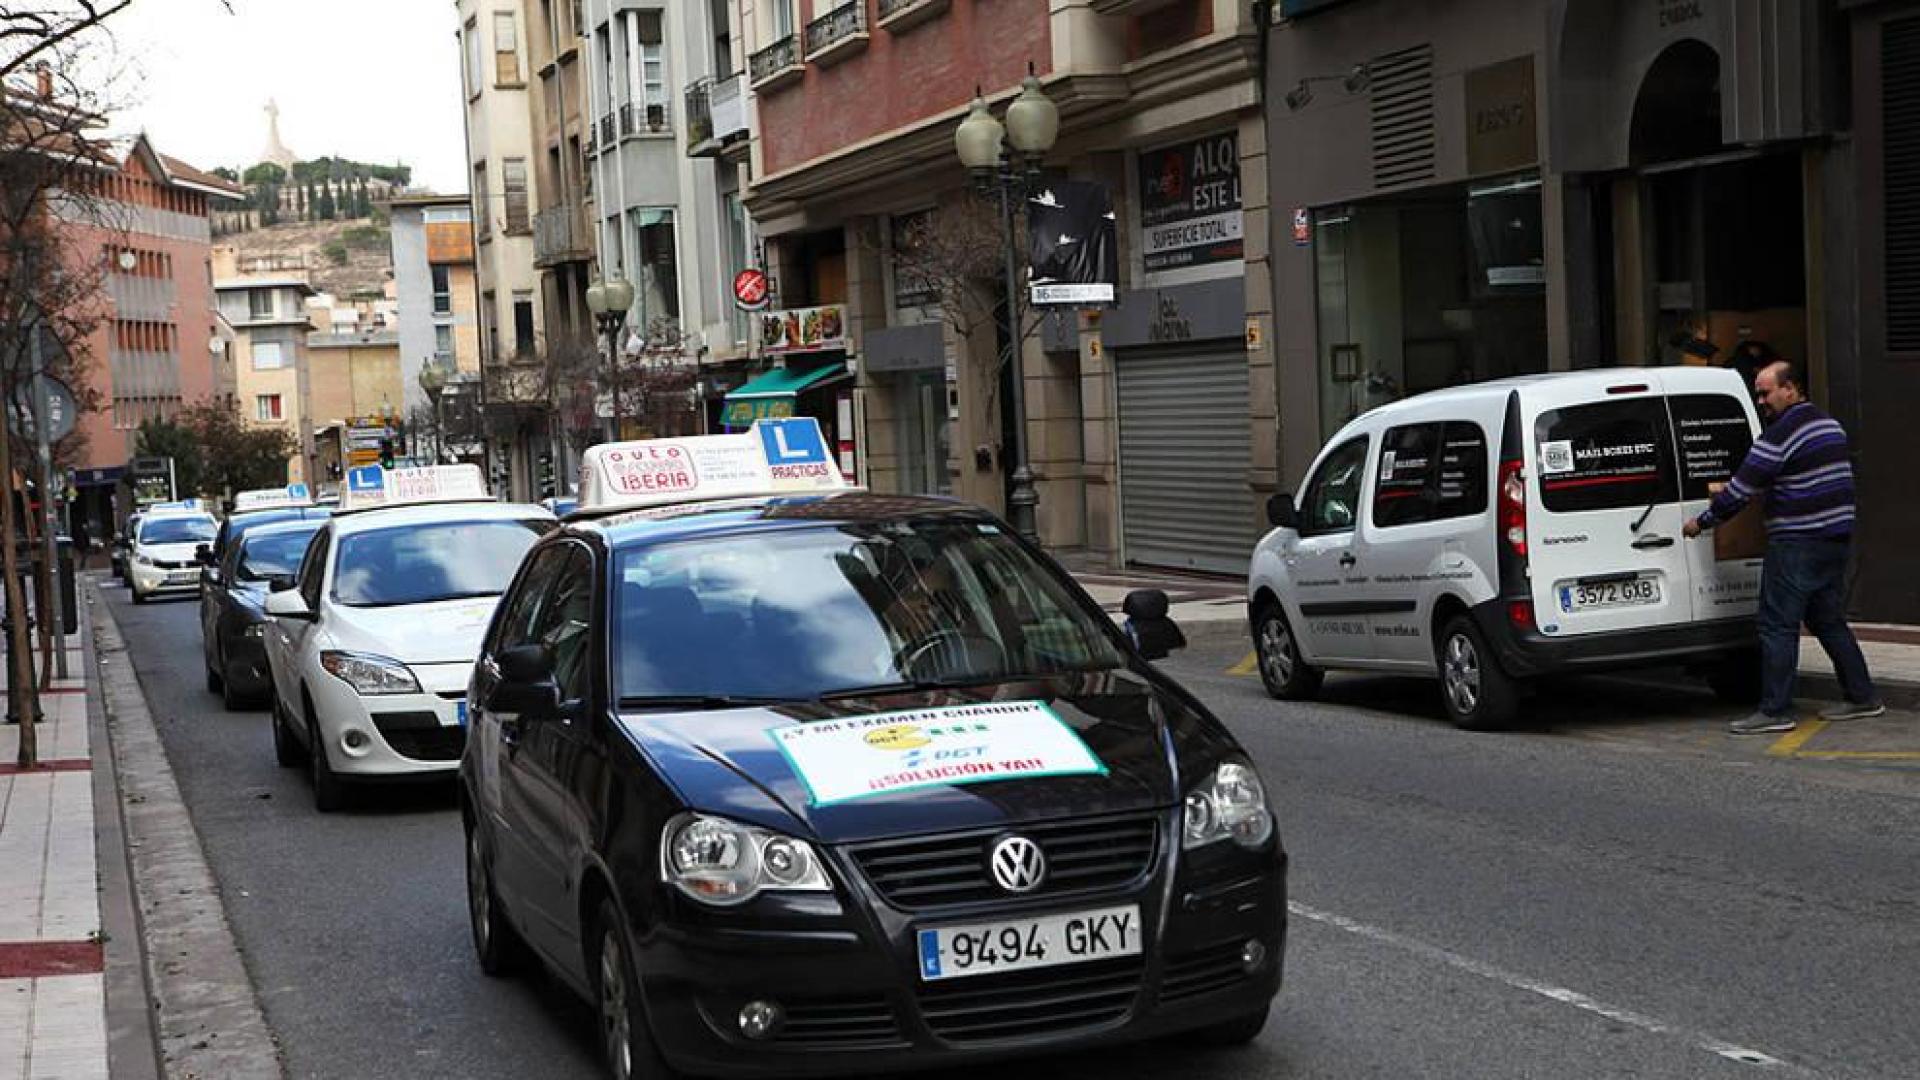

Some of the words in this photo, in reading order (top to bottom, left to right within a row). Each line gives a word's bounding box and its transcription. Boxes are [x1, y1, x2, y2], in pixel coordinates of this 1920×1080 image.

[1192, 181, 1227, 211] ESTE
[1152, 223, 1198, 249] SUPERFICIE
[1199, 219, 1227, 241] TOTAL
[774, 425, 809, 458] L
[1576, 449, 1602, 460] MAIL
[356, 469, 378, 489] L
[621, 472, 690, 491] IBERIA
[1576, 583, 1617, 604] 3572
[1621, 580, 1654, 600] GXB
[951, 923, 1046, 968] 9494
[1064, 912, 1131, 955] GKY
